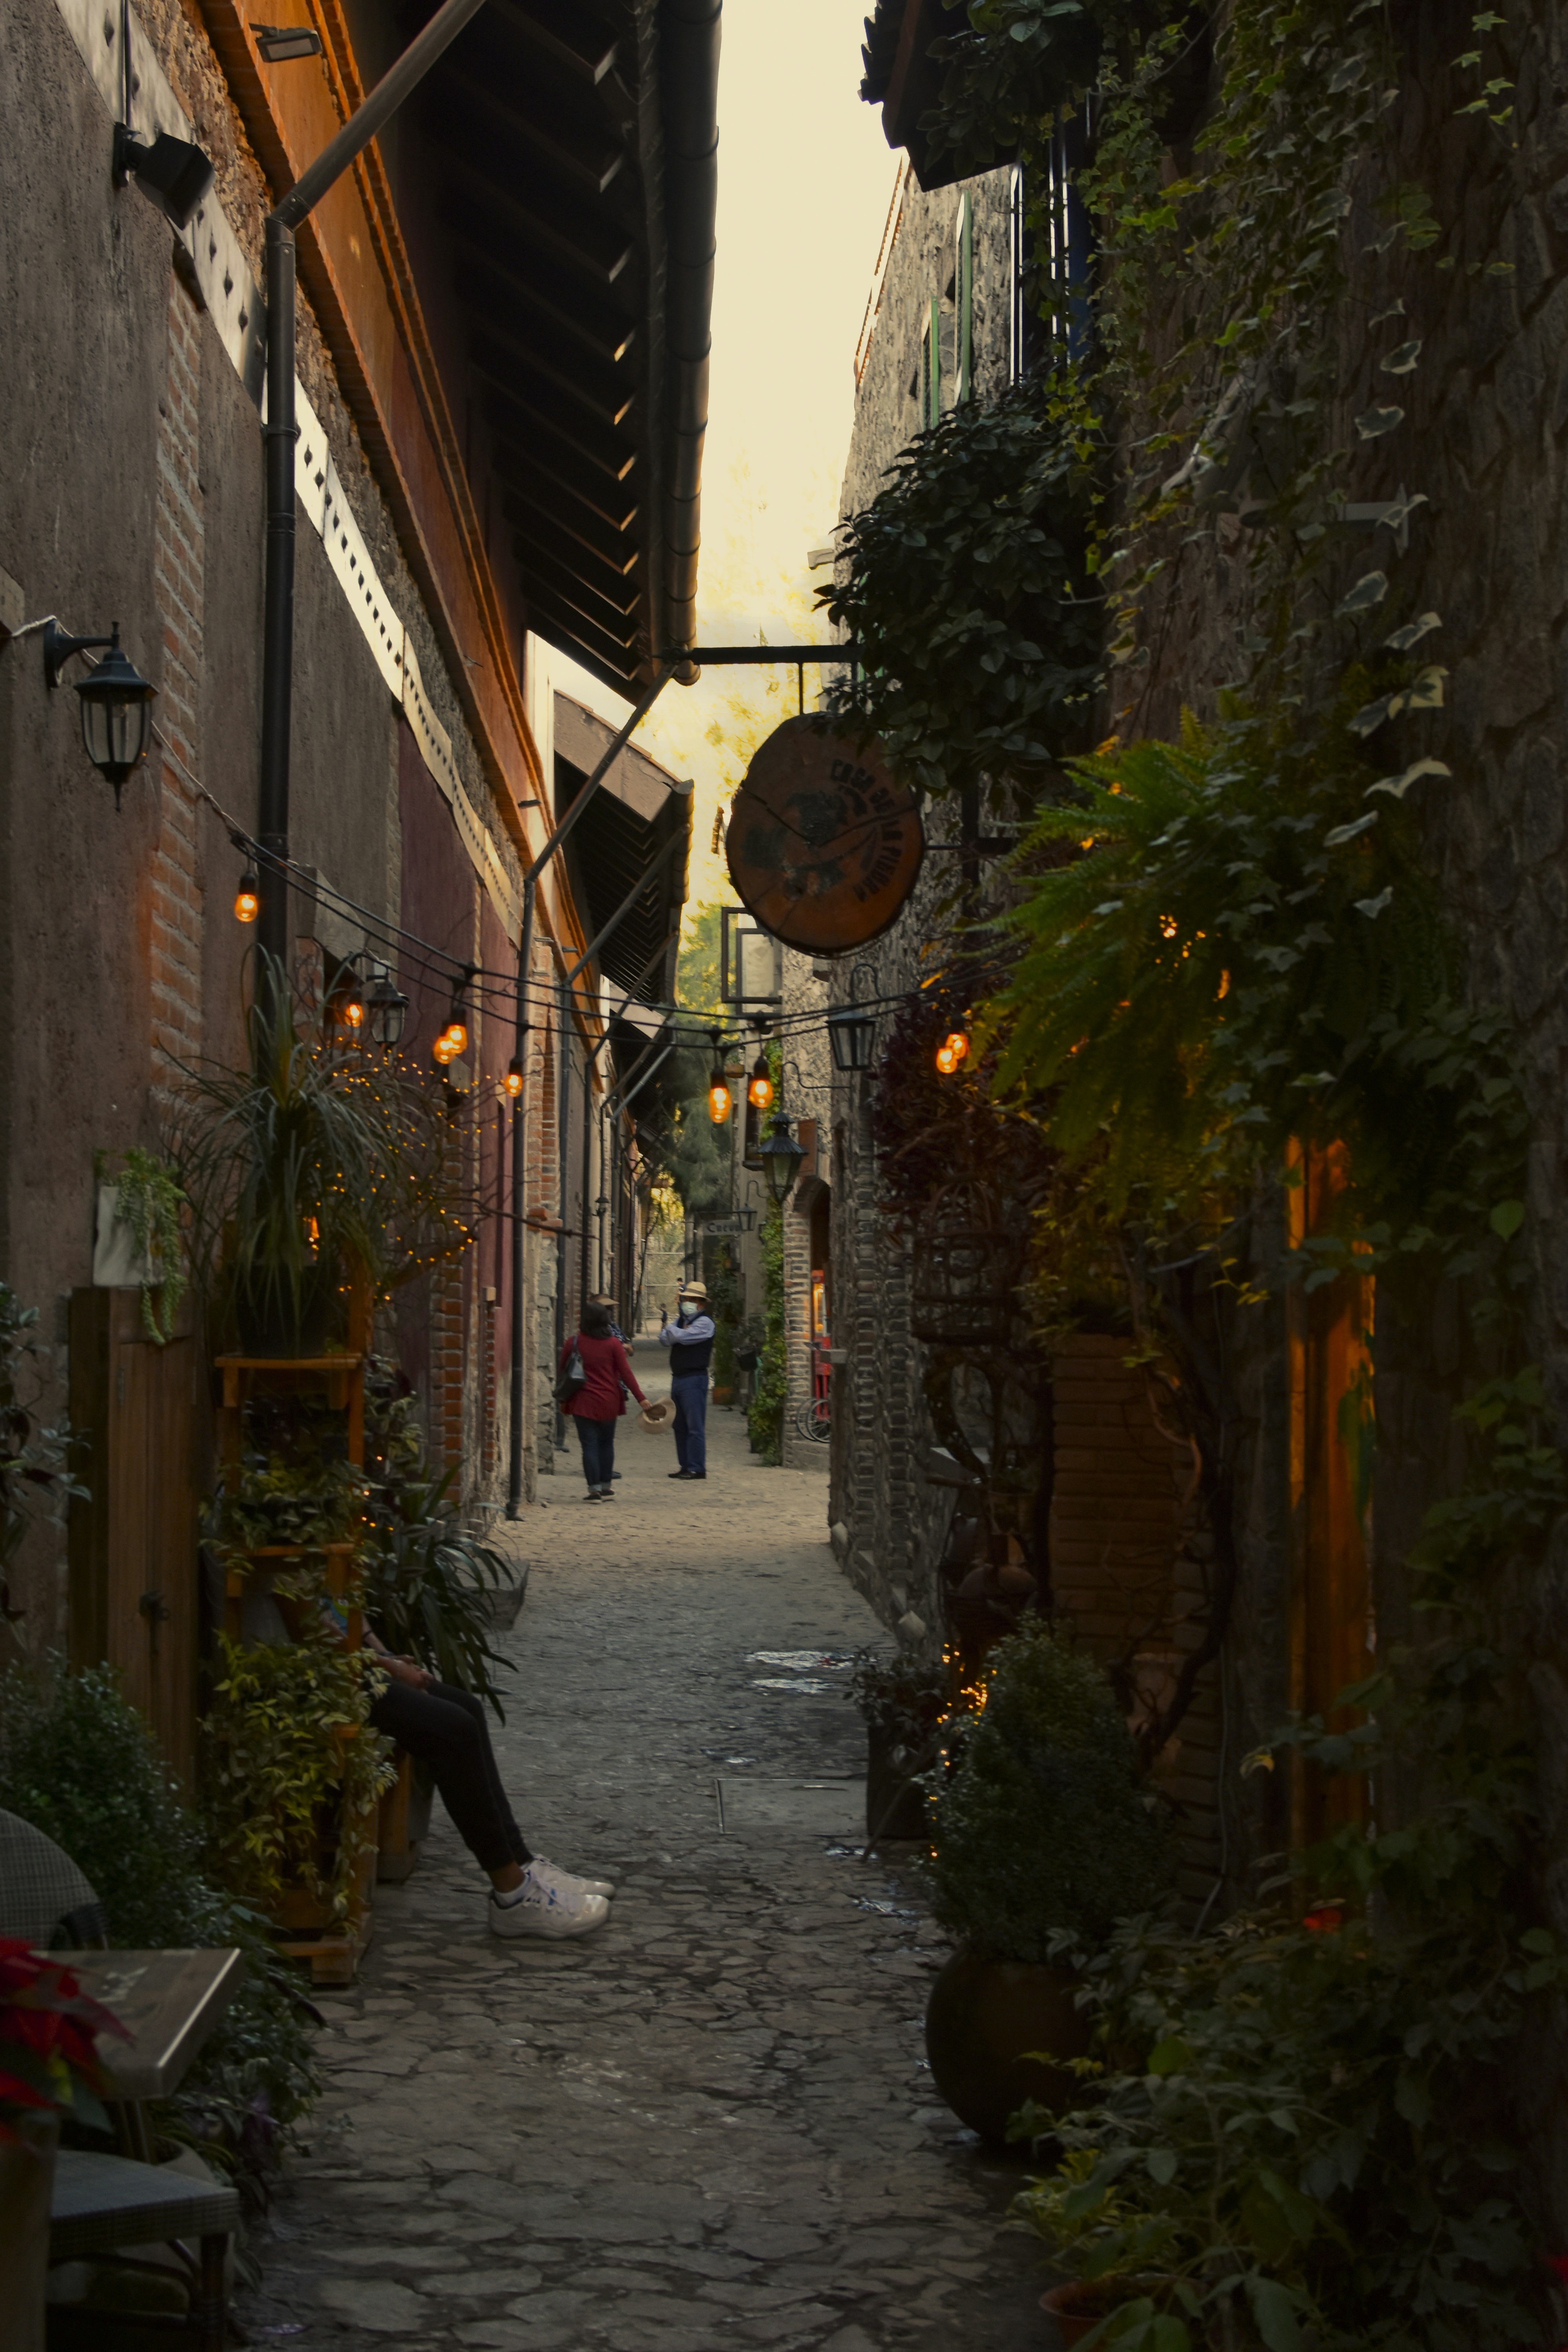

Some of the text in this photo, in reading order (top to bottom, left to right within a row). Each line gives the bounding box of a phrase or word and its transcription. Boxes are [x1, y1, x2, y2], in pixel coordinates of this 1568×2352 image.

[830, 759, 903, 902] CASA DE LA PIEDRA
